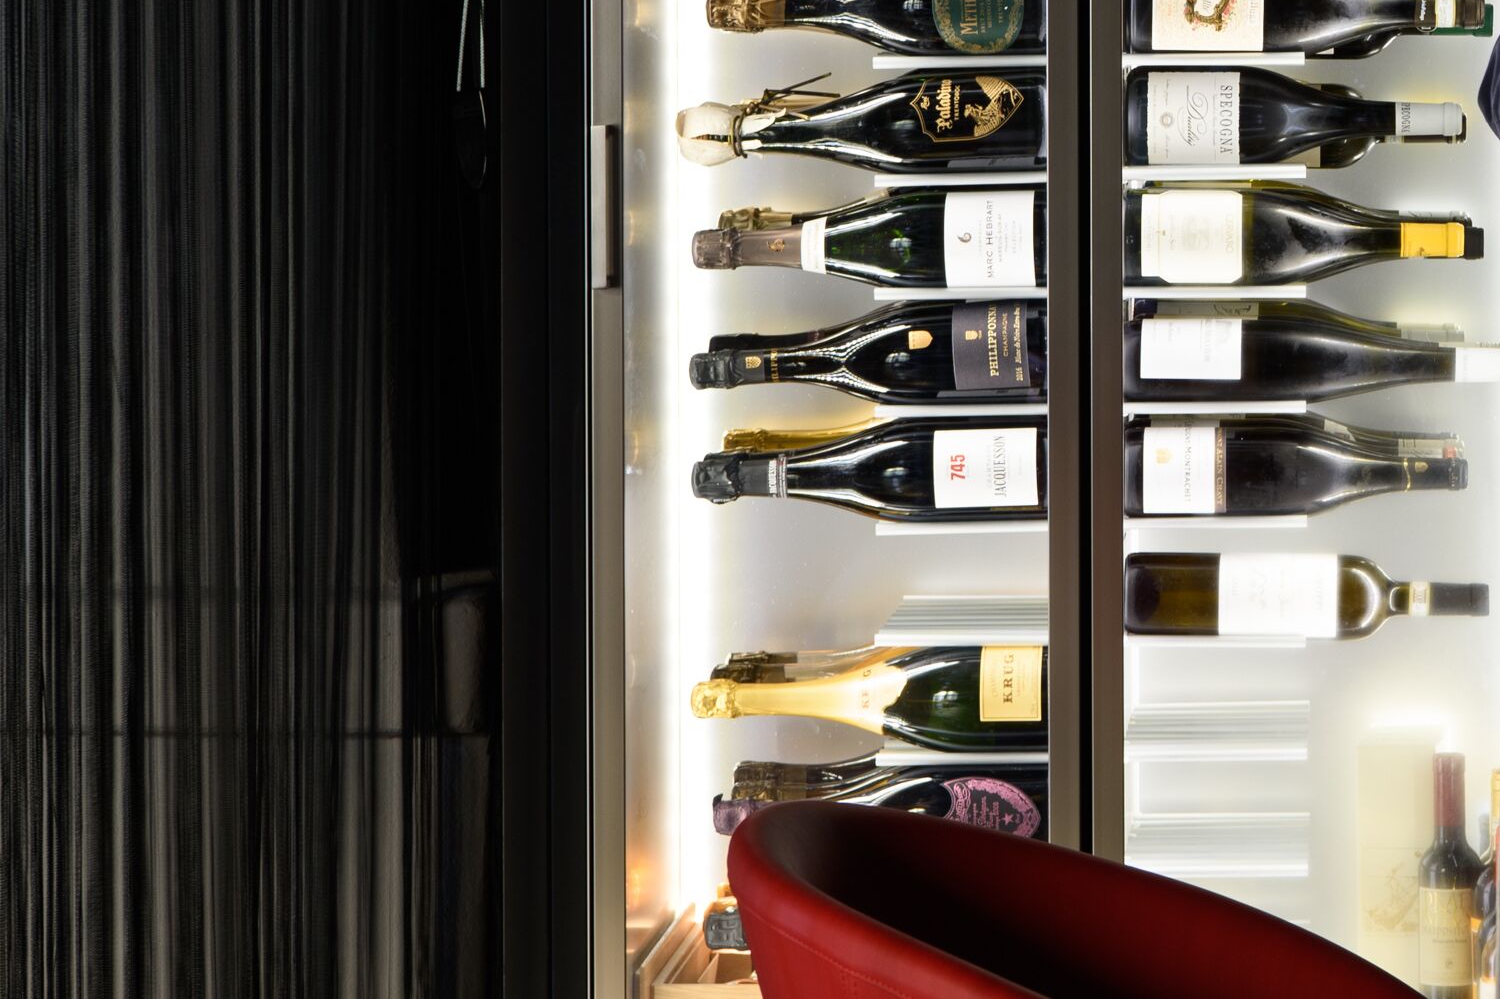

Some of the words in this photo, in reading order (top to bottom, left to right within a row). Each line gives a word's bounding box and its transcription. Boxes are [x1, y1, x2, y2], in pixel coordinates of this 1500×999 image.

[935, 79, 953, 133] Paladino
[1177, 84, 1209, 147] Duality
[1219, 84, 1234, 155] SPECOGNA
[985, 199, 993, 242] HEBRART
[986, 250, 994, 279] MARC
[950, 453, 966, 480] 745
[993, 434, 1007, 498] JACQUESSON
[1216, 447, 1225, 475] ALAIN
[1216, 476, 1225, 505] CHAVY
[1003, 653, 1014, 704] KRUG
